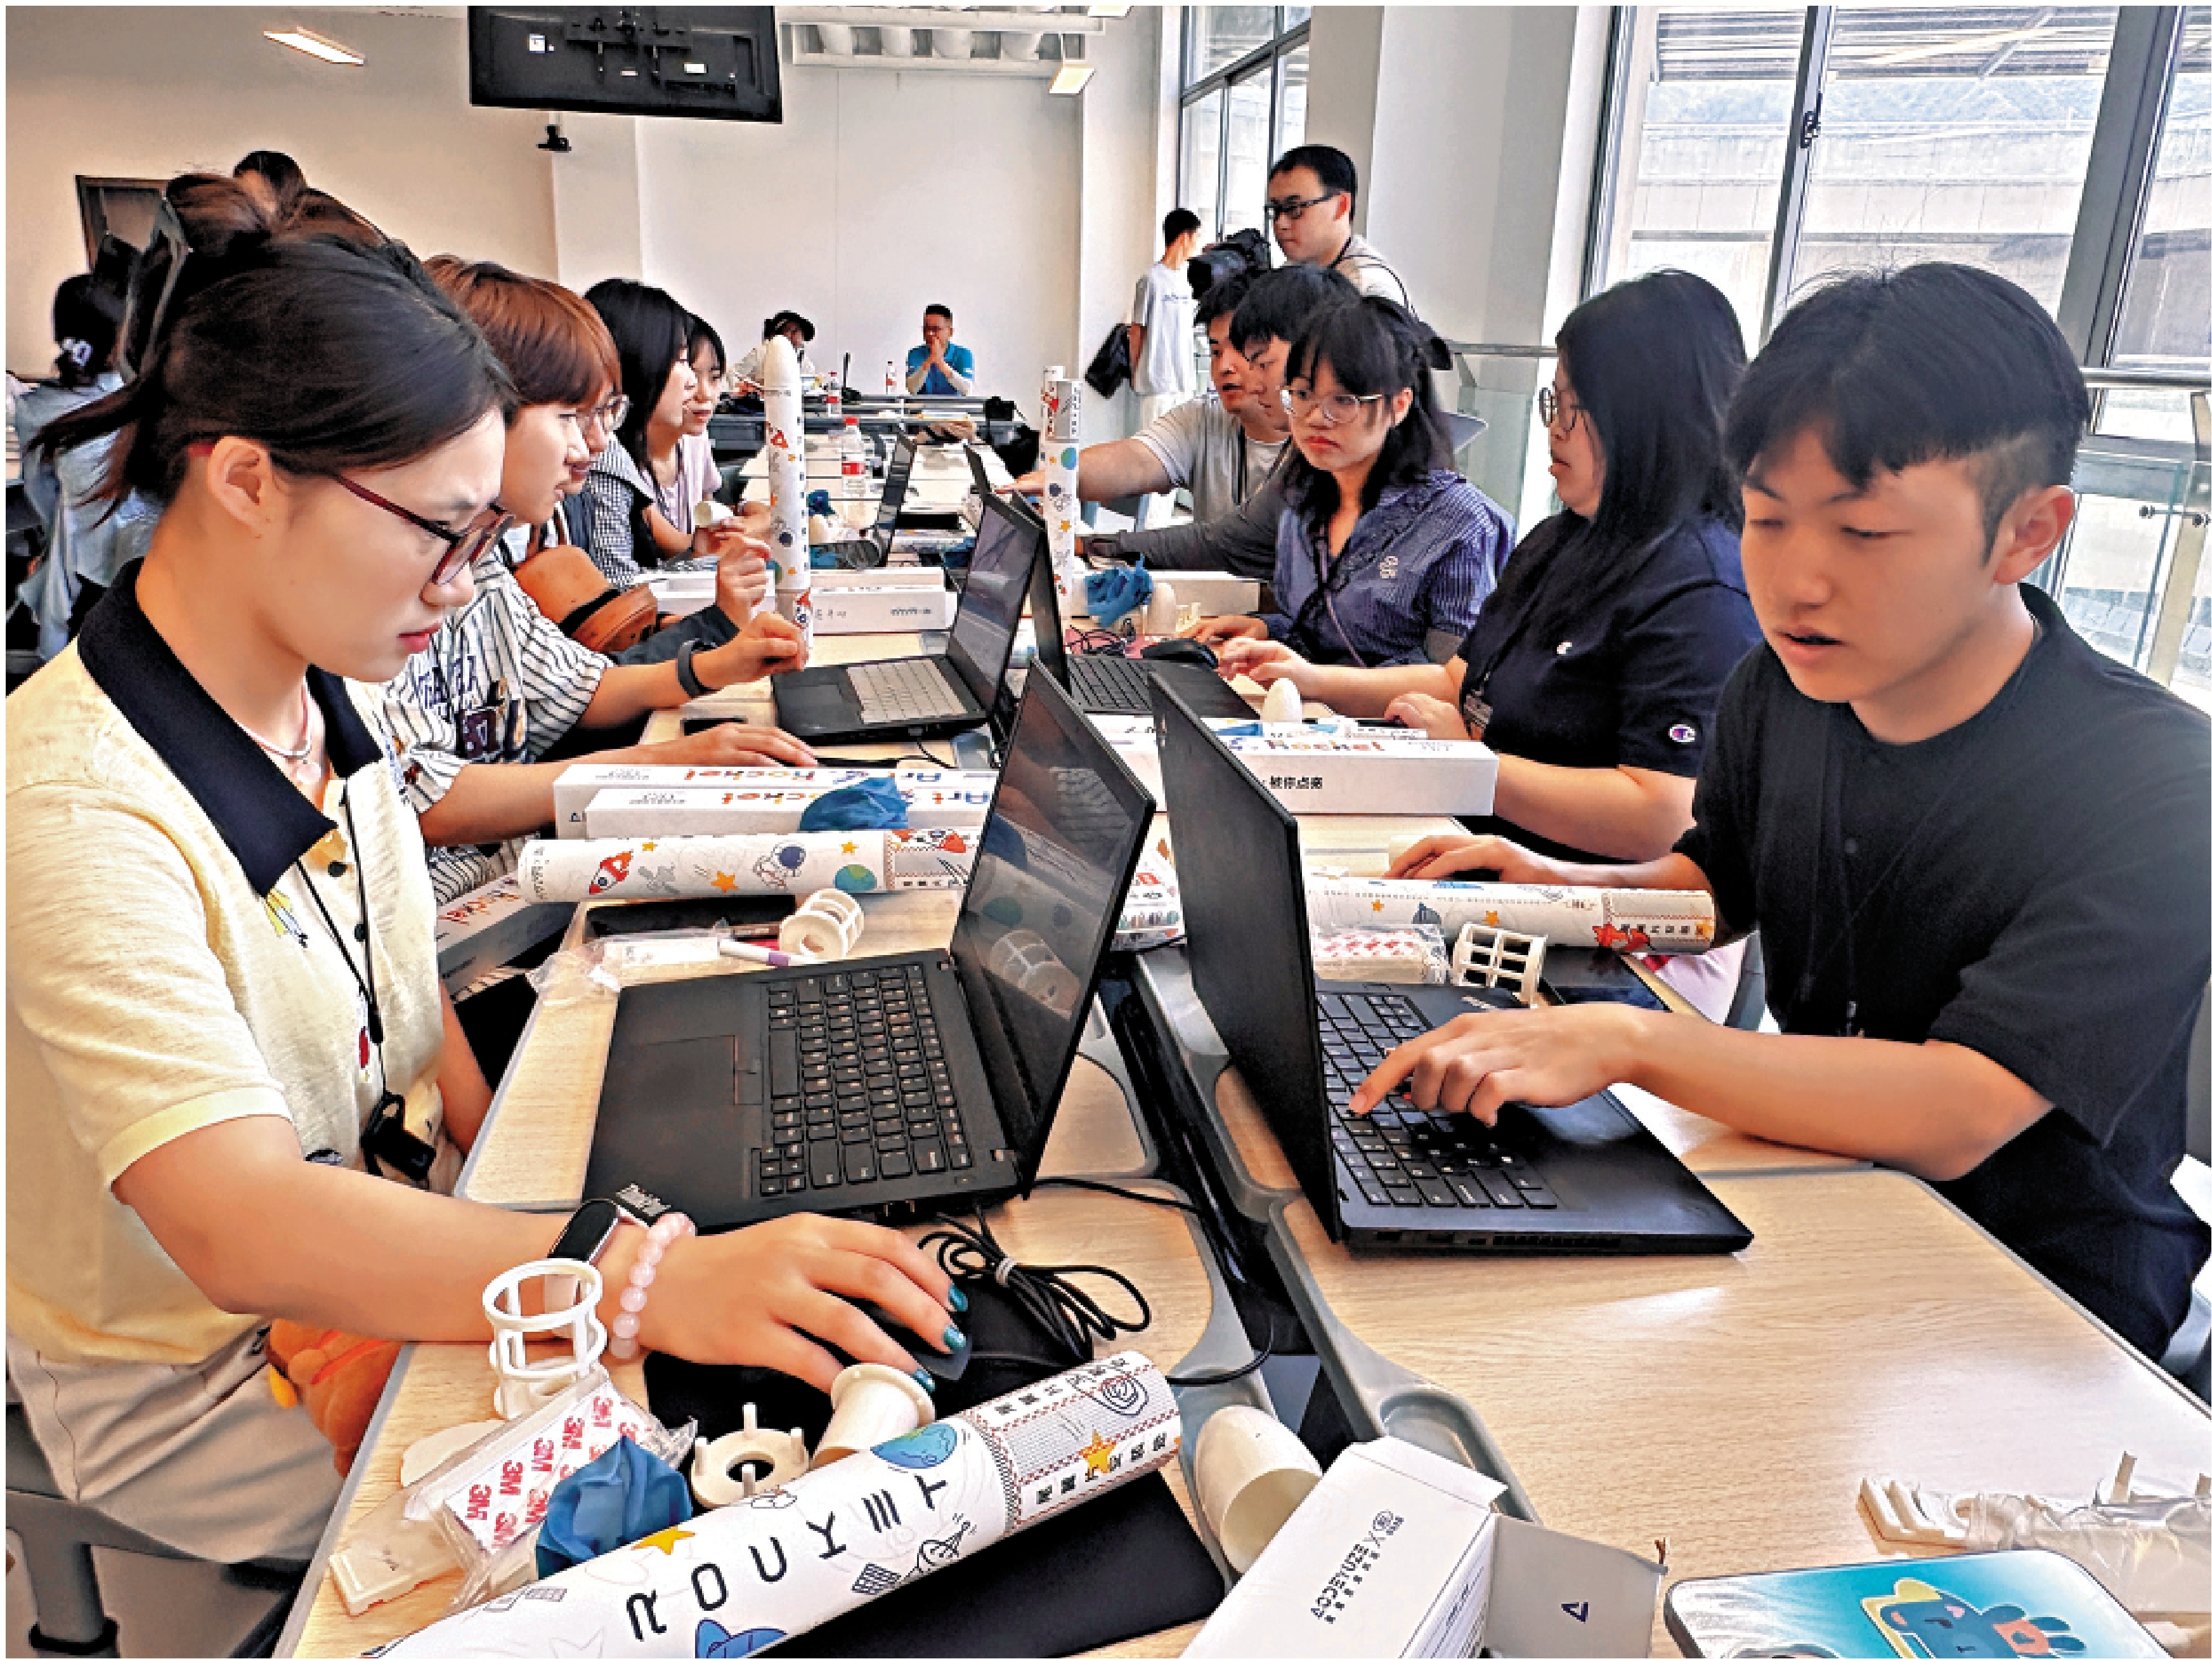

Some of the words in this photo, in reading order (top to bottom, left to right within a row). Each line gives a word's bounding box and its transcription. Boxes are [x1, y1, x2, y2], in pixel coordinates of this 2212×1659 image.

[563, 1415, 585, 1450] 3M
[531, 1438, 554, 1472] 3M
[499, 1460, 523, 1496] 3M
[465, 1484, 492, 1521] 3M
